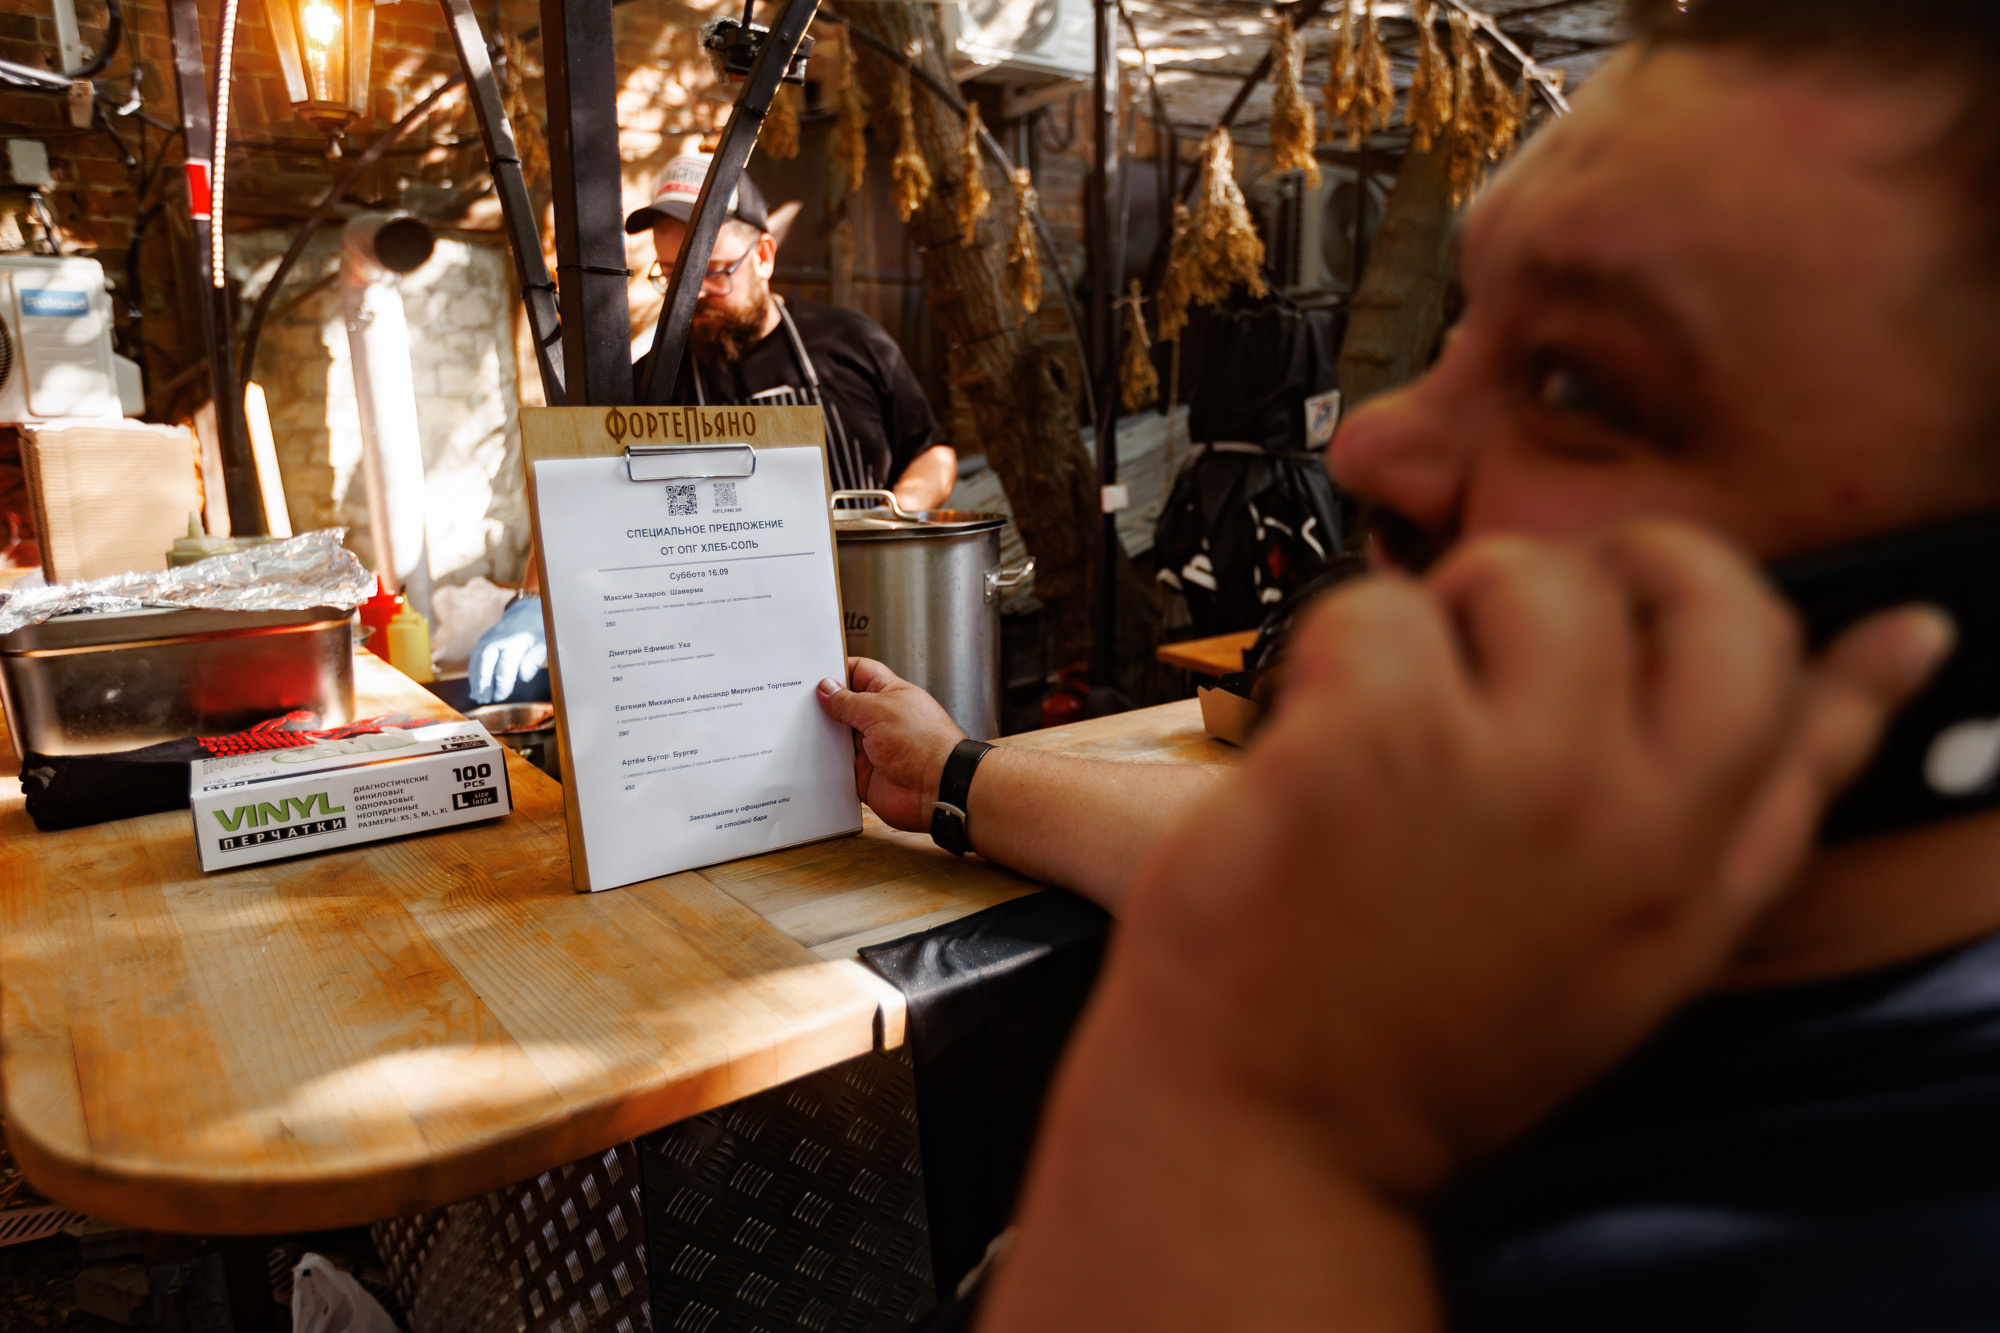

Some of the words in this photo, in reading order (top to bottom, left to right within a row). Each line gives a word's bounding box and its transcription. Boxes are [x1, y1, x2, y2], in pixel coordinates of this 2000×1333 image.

[605, 406, 756, 444] ФОРТЕПЬЯНО
[626, 524, 706, 538] СПЕЦИАЛЬНОЕ
[709, 520, 784, 533] ПРЕДЛОЖЕНИЕ
[660, 546, 674, 556] ОТ
[678, 545, 698, 554] ОПГ
[701, 540, 759, 552] ХЛЕБ-СОЛЬ
[670, 570, 706, 581] Суббота
[708, 568, 729, 577] 16.09
[604, 594, 632, 602] Максим
[635, 590, 668, 599] Захаров:
[670, 587, 703, 596] Шаверма
[609, 648, 642, 658] Дмитрий
[644, 644, 676, 653] Ефимов:
[615, 702, 646, 711] Евгений
[649, 697, 685, 707] Михайлов
[692, 690, 729, 700] Александр
[731, 686, 765, 695] Меркулов:
[767, 680, 802, 690] Тортелини
[622, 757, 645, 767] Артём
[647, 753, 671, 763] Бугор:
[673, 749, 698, 758] Бургер
[453, 764, 491, 782] 100
[353, 775, 429, 794] ДИАГНОСТИЧЕСКИЕ
[464, 780, 485, 789] PCS
[354, 788, 404, 802] ВИНИЛОВЫЕ
[457, 794, 469, 808] L
[472, 797, 492, 806] large
[355, 796, 414, 811] ОДНОРАЗОВЫЕ
[689, 808, 734, 822] Заказывайте
[740, 799, 777, 812] официанта
[212, 792, 345, 832] VINYL
[357, 804, 419, 820] НЕОПУДРЕННЫЕ
[358, 816, 399, 829] РАЗМЕРЫ:
[400, 814, 412, 822] XS,
[724, 817, 751, 828] стойкой
[753, 814, 768, 822] бара
[222, 818, 344, 850] ПЕРЧАТКИ
